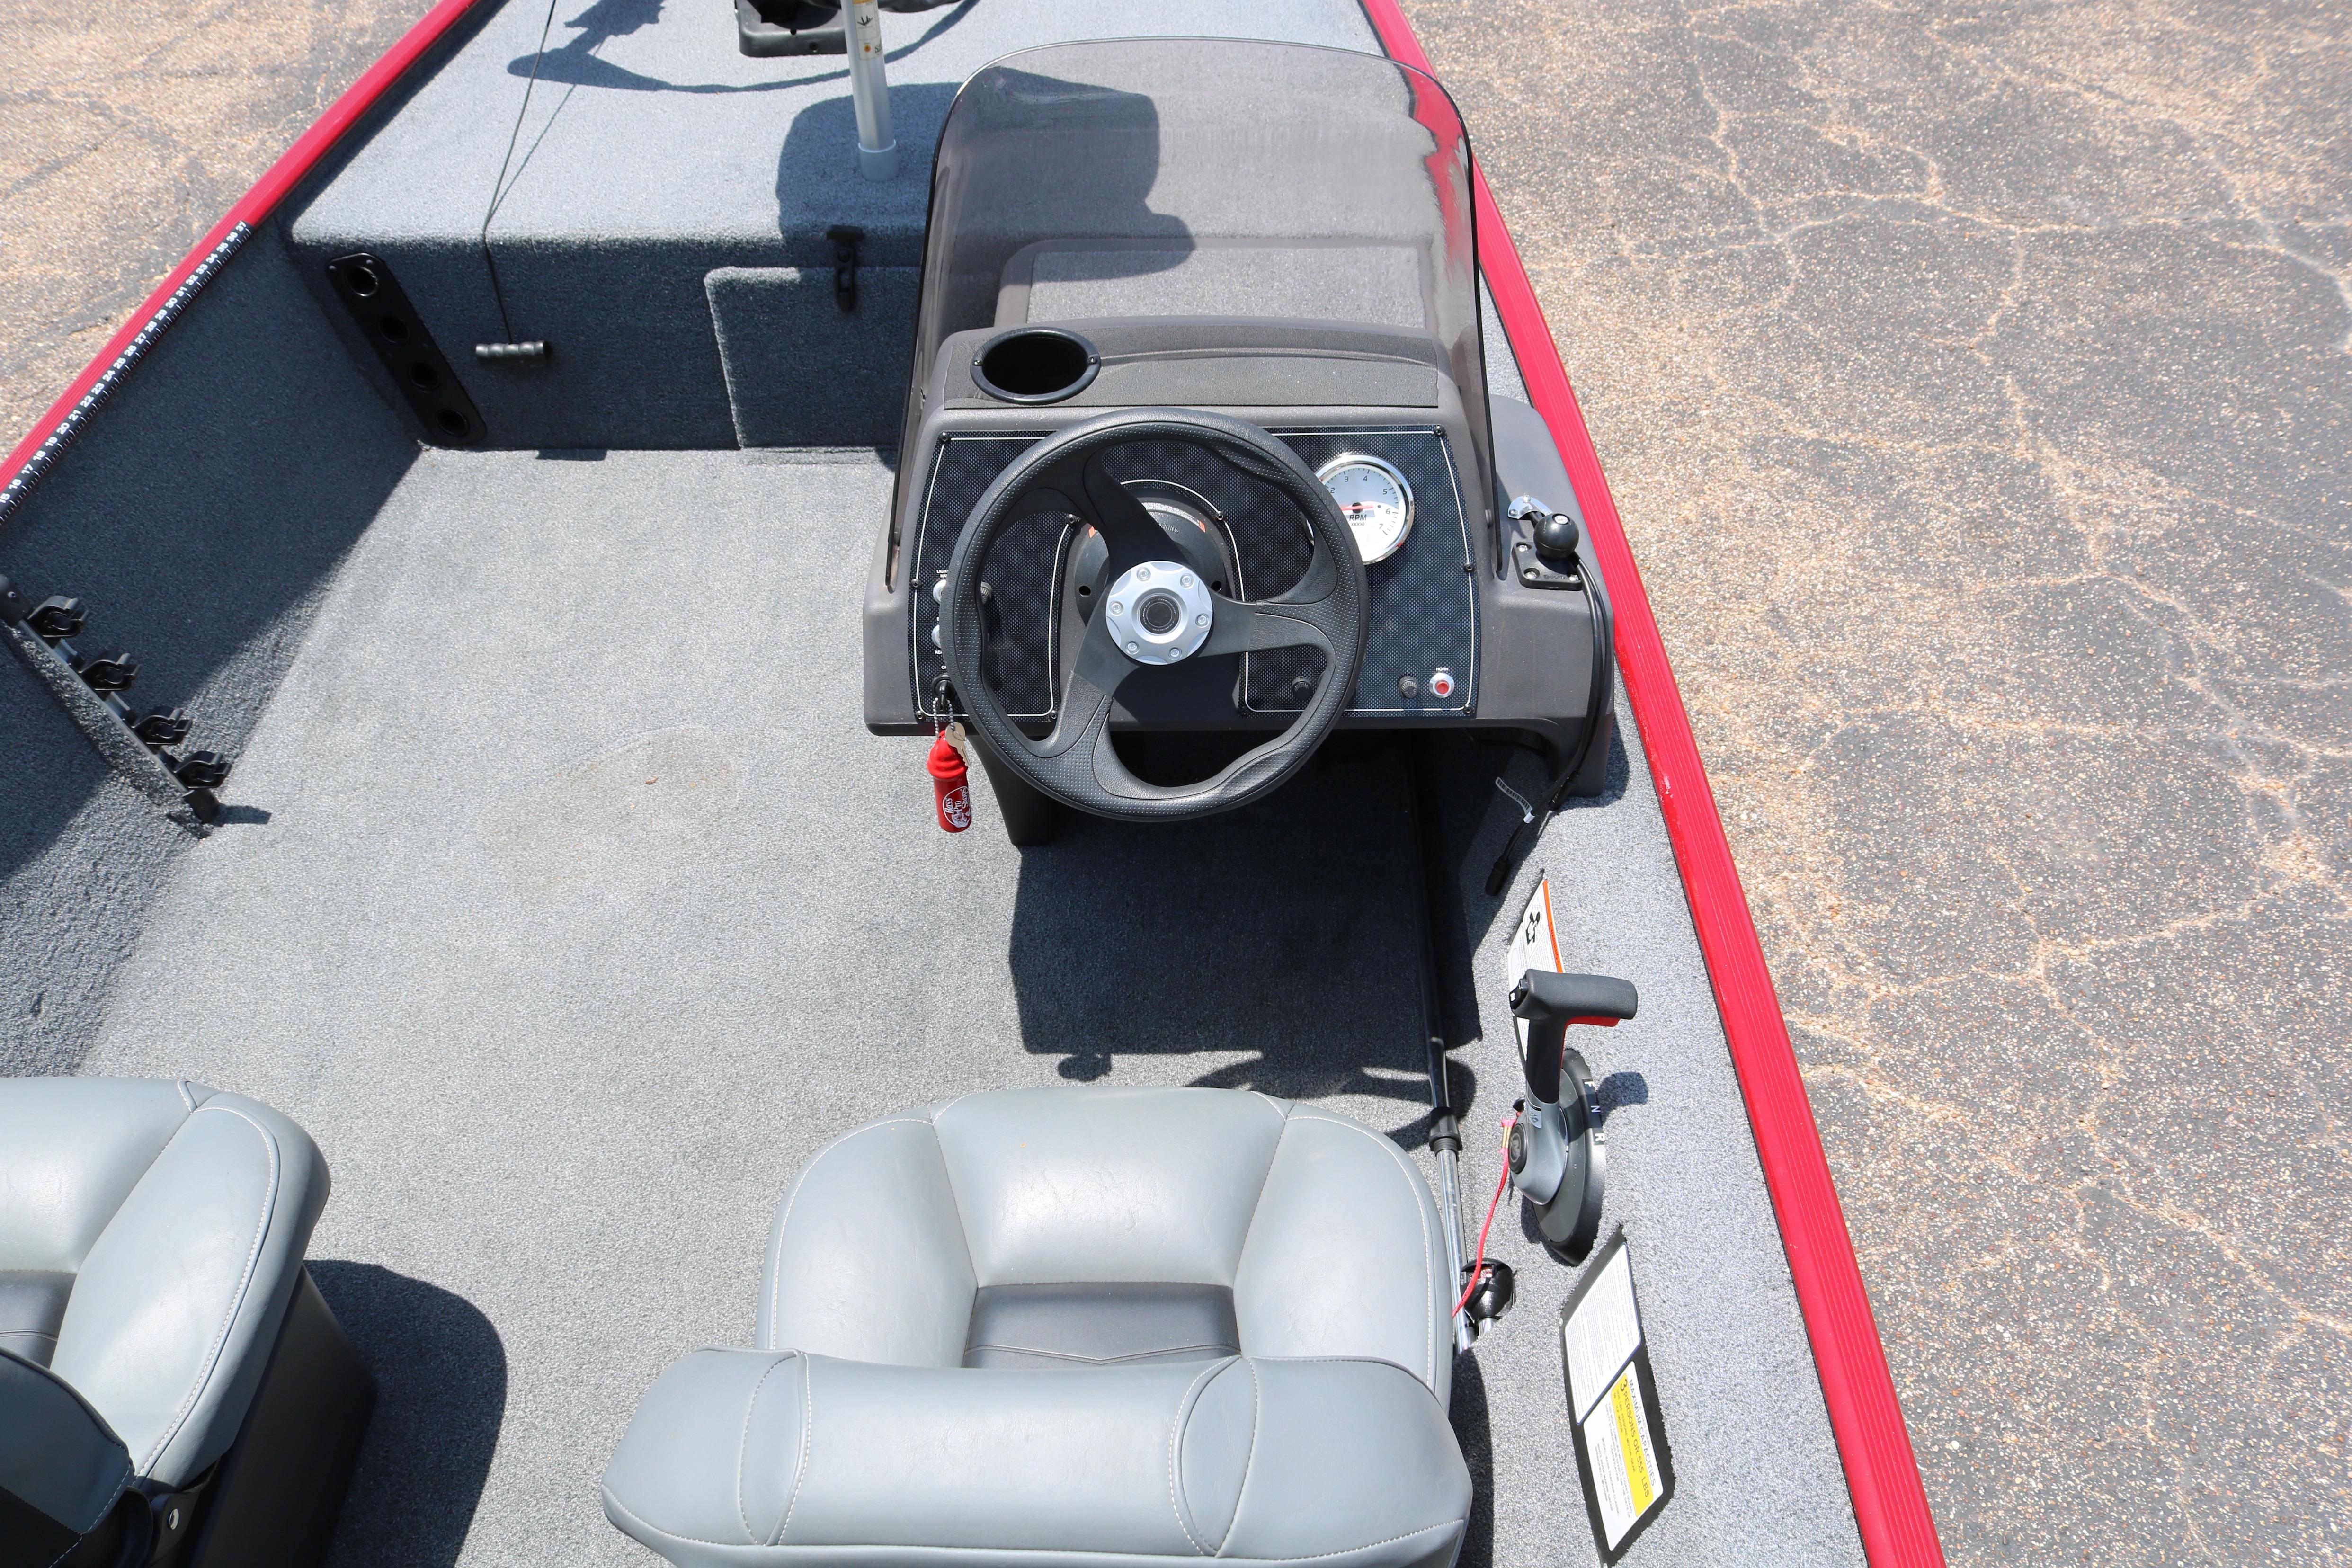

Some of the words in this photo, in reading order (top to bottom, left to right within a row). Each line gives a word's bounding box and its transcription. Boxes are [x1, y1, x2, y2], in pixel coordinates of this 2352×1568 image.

[9, 479, 22, 489] 16
[21, 464, 33, 474] 17
[33, 450, 46, 461] 18
[45, 437, 58, 446] 19
[57, 422, 70, 435] 20
[68, 410, 81, 421] 21
[80, 395, 94, 408] 22
[91, 383, 105, 395] 23
[102, 370, 116, 382] 24
[113, 357, 126, 369] 25
[124, 345, 137, 356] 26
[134, 332, 146, 344] 27
[144, 321, 157, 332] 28
[155, 309, 167, 321] 29
[165, 297, 178, 308] 30
[176, 286, 187, 297] 31
[185, 275, 198, 285] 32
[196, 263, 208, 274] 33
[205, 253, 218, 264] 34
[216, 242, 228, 253] 35
[226, 232, 238, 242] 36
[235, 220, 246, 232] 37
[944, 797, 954, 814] Bass
[953, 801, 962, 812] Pro
[1595, 1133, 1605, 1141] R
[1620, 1378, 1628, 1392] 3
[1623, 1391, 1636, 1438] PERSONS
[1629, 1380, 1641, 1425] MAXIMUM
[1639, 1425, 1655, 1486] CAPACITIES
[1633, 1438, 1640, 1454] OR
